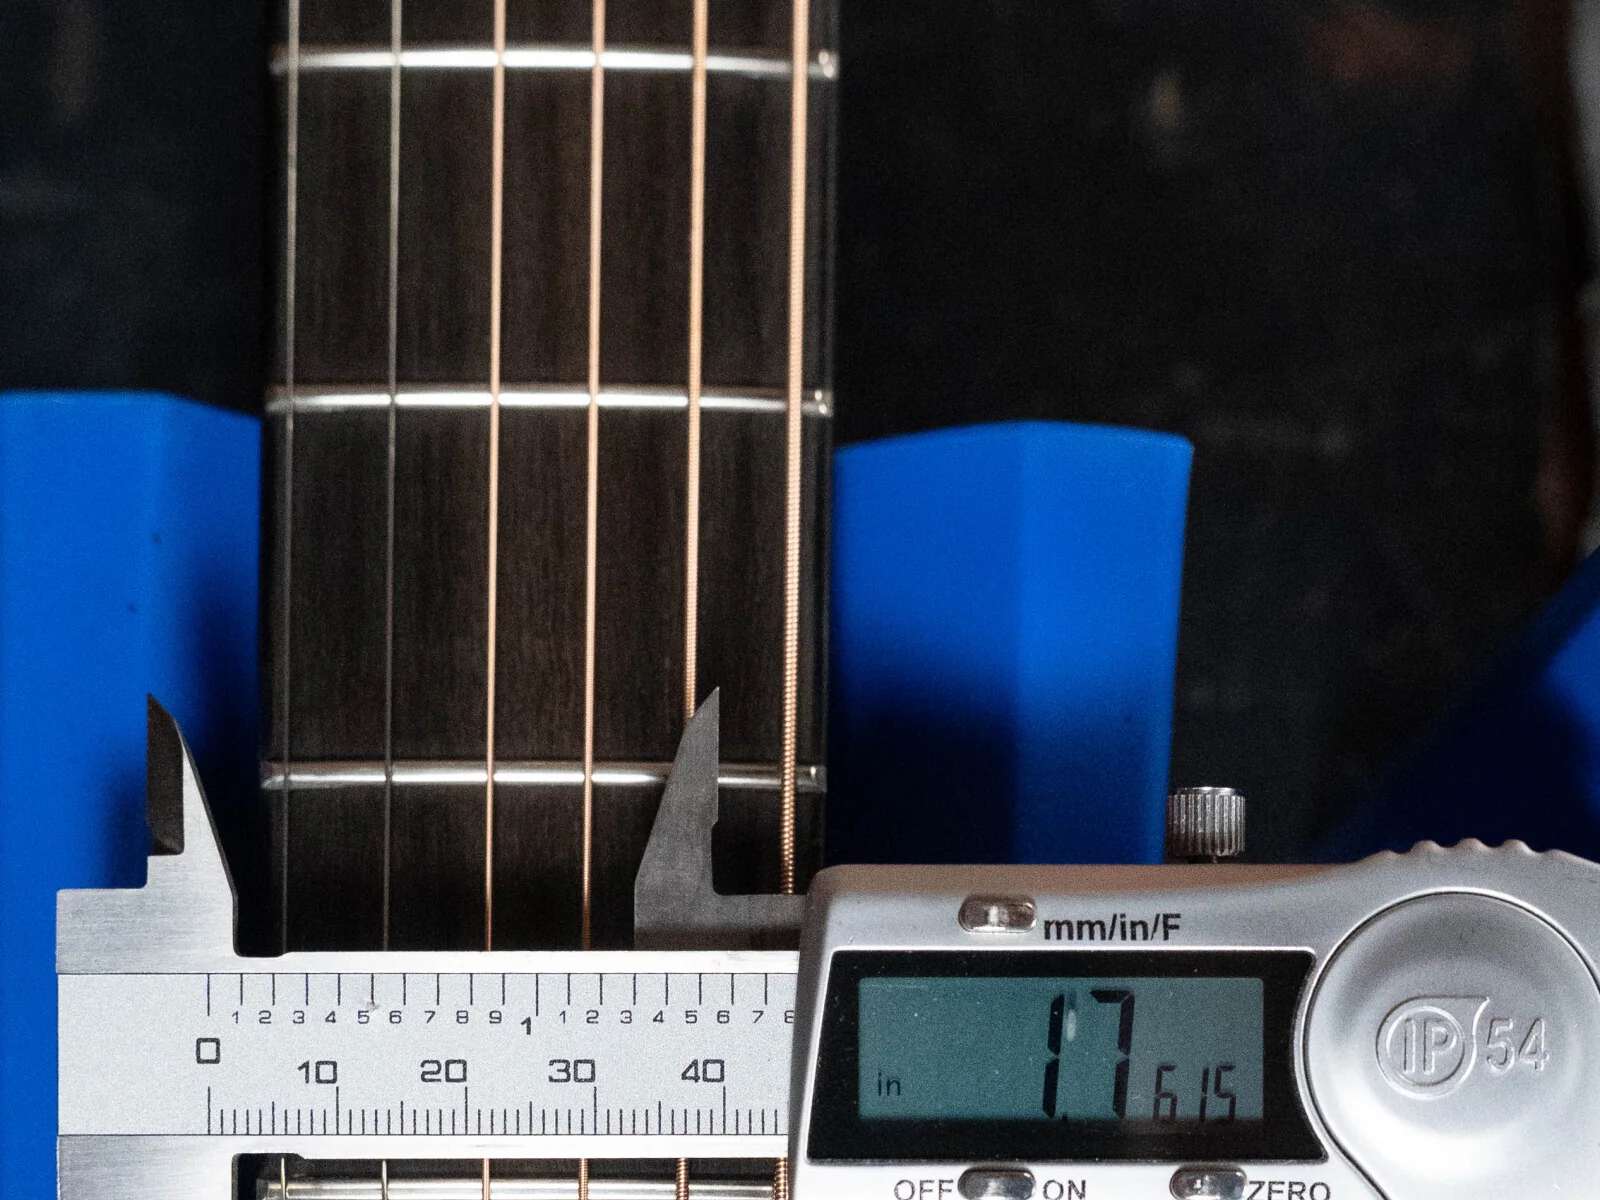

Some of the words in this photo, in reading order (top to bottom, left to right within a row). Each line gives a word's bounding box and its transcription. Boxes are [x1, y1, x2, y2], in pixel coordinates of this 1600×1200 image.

[1043, 912, 1182, 942] mm/in/F
[231, 1010, 240, 1025] 1
[258, 1010, 272, 1025] 2
[292, 1010, 305, 1025] 3
[325, 1010, 337, 1025] 4
[357, 1010, 370, 1025] 5
[388, 1010, 402, 1025] 6
[424, 1010, 436, 1025] 7
[456, 1010, 469, 1025] 8
[489, 1010, 502, 1025] 9
[520, 1016, 532, 1036] 1
[559, 1010, 567, 1025] 1
[586, 1010, 599, 1025] 2
[620, 1010, 633, 1025] 3
[652, 1010, 665, 1025] 4
[685, 1010, 698, 1025] 5
[717, 1010, 730, 1025] 6
[752, 1010, 764, 1025] 7
[1401, 1016, 1457, 1075] IP
[1486, 1016, 1549, 1073] 54
[196, 1037, 221, 1065] 0
[297, 1060, 338, 1085] 10
[420, 1059, 468, 1083] 20
[548, 1059, 596, 1083] 30
[681, 1059, 725, 1083] 40
[877, 1071, 901, 1097] in
